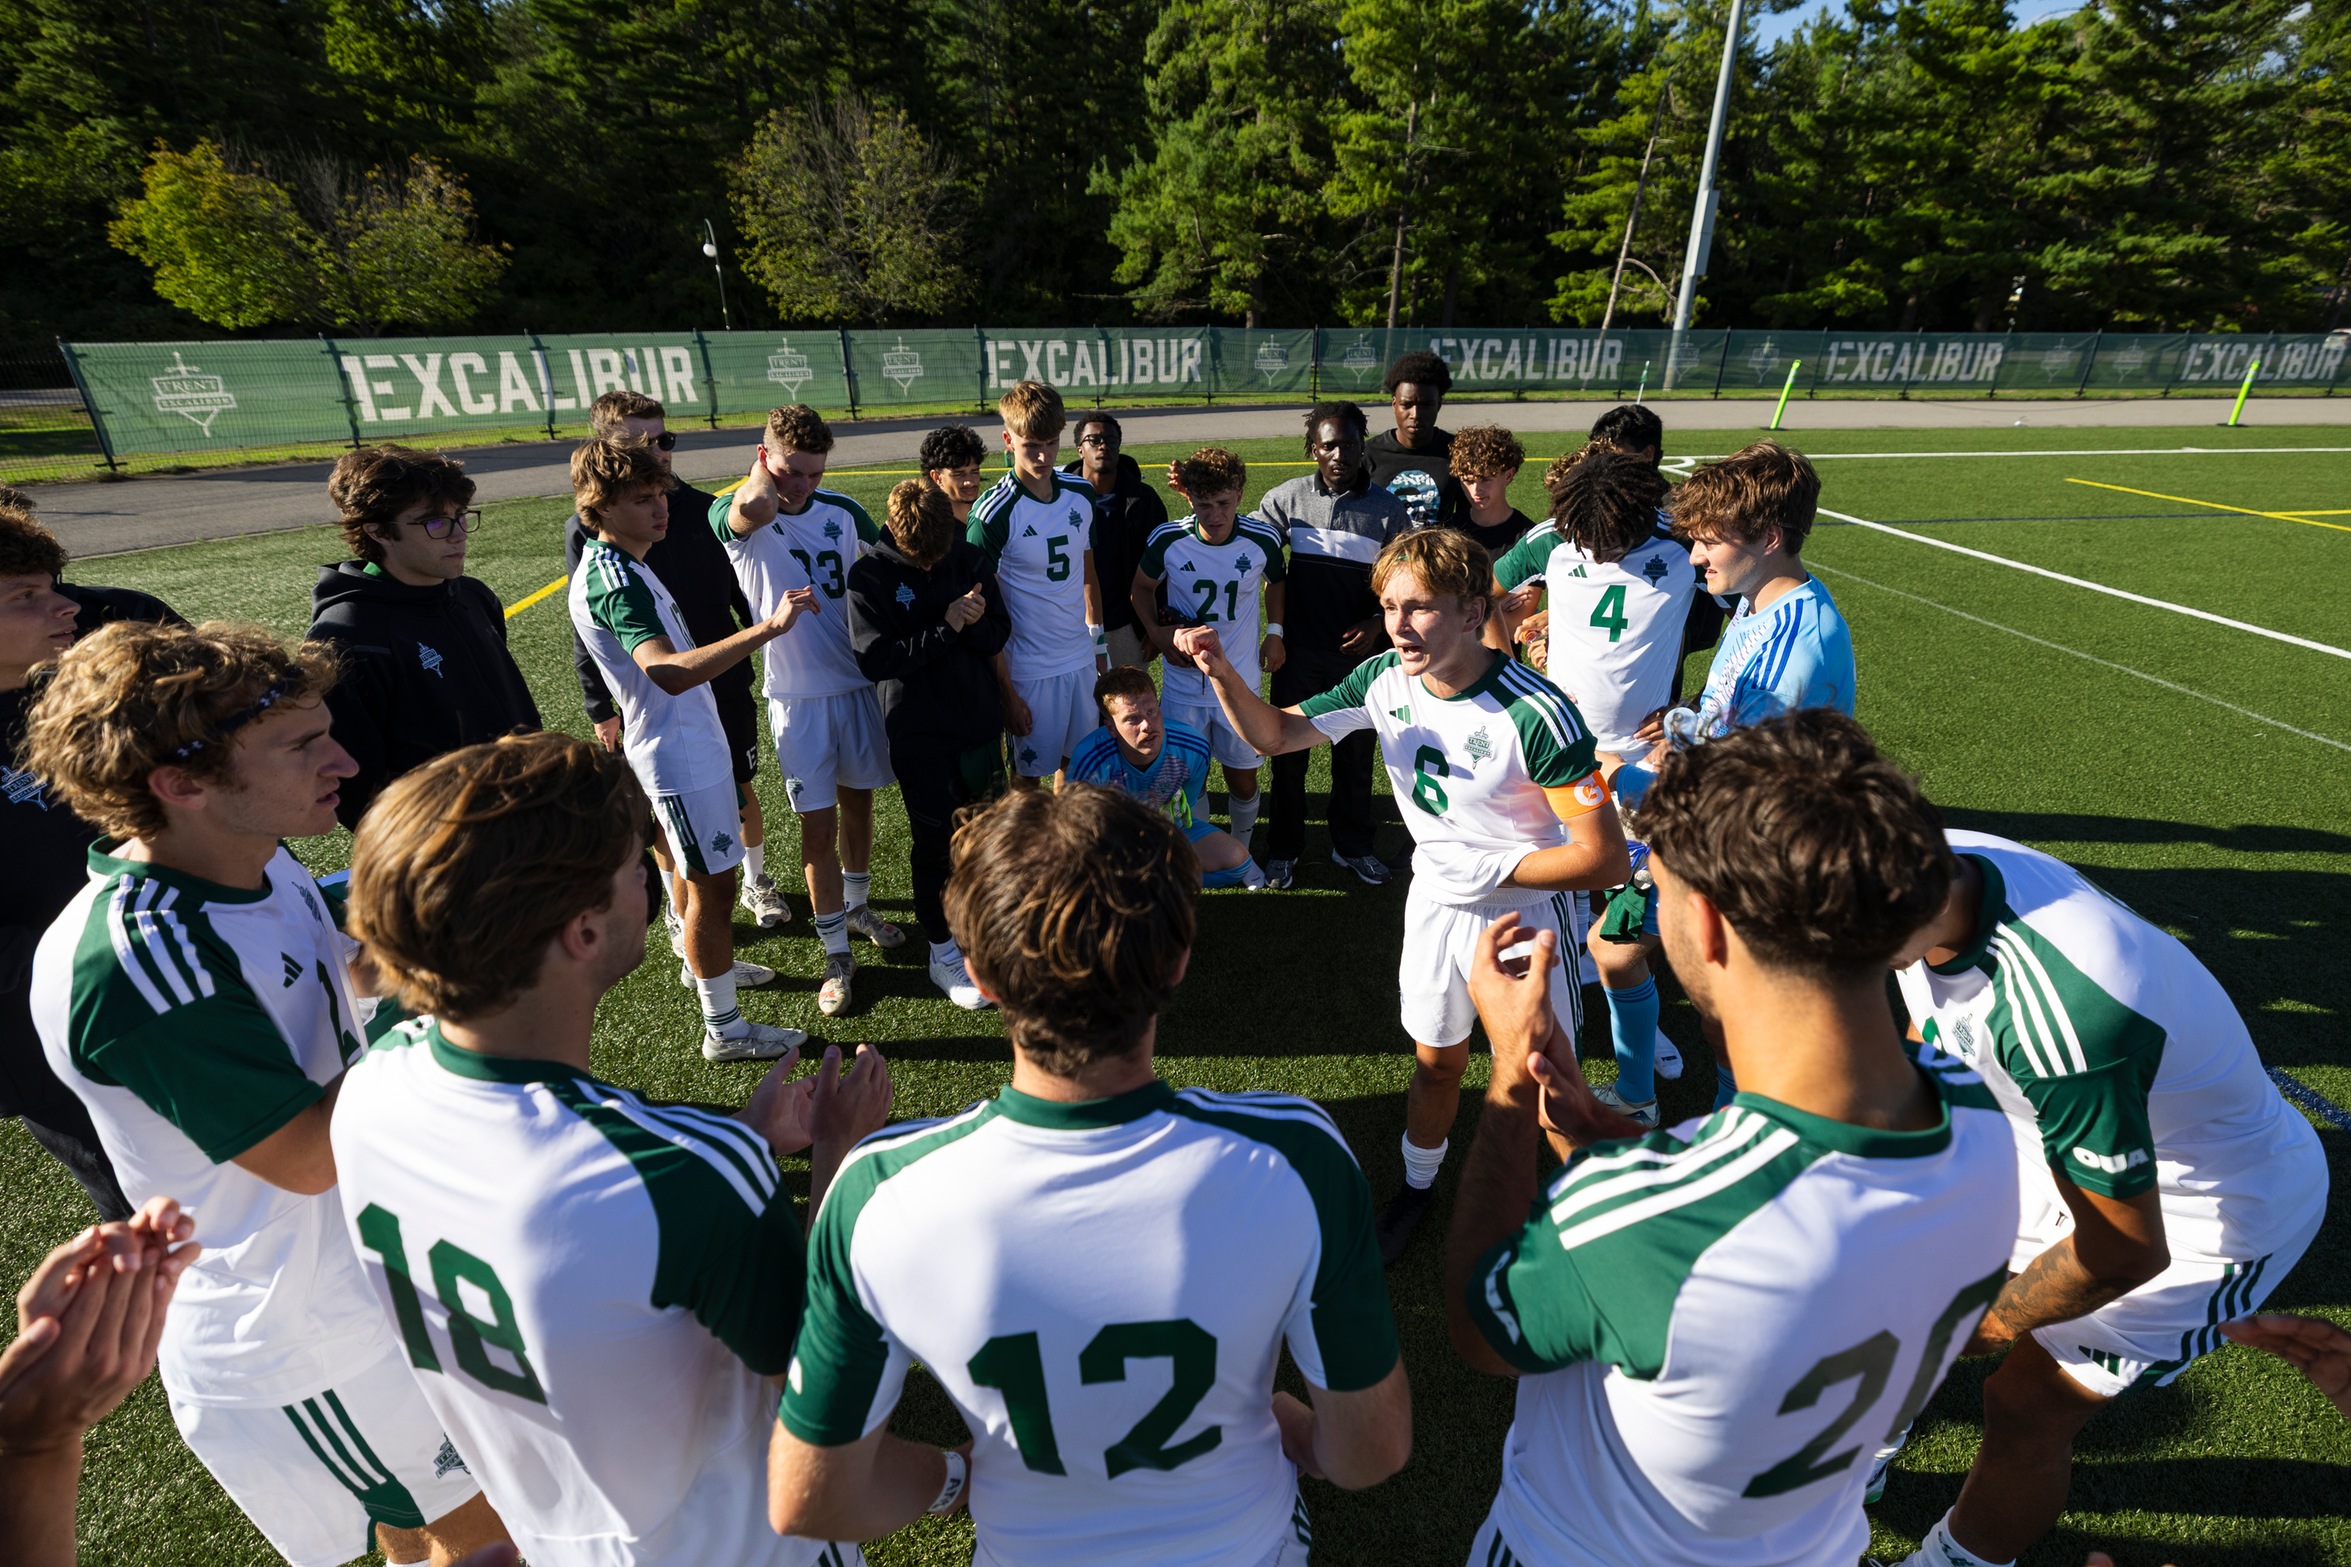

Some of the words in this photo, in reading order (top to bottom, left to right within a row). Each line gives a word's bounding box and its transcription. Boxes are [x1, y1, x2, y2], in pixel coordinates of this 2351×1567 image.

[771, 357, 805, 368] TRENT
[887, 354, 917, 366] TRENT
[985, 338, 1202, 389] EXCALIBUR
[1430, 338, 1624, 380] EXCALIBUR
[1823, 341, 2005, 382] EXCALIBUR
[2179, 343, 2346, 381] EXCALIBUR
[158, 380, 218, 393] TRENT
[160, 397, 232, 407] EXCALIBUR
[341, 347, 699, 422] EXCALIBUR
[1046, 534, 1071, 582] 5
[1192, 579, 1239, 622] 21
[1589, 584, 1629, 643] 4
[4, 773, 37, 792] TRENT
[1411, 744, 1450, 817] 6
[2073, 1147, 2150, 1174] OUA
[357, 1202, 548, 1405] 18
[967, 1318, 1222, 1480] 12
